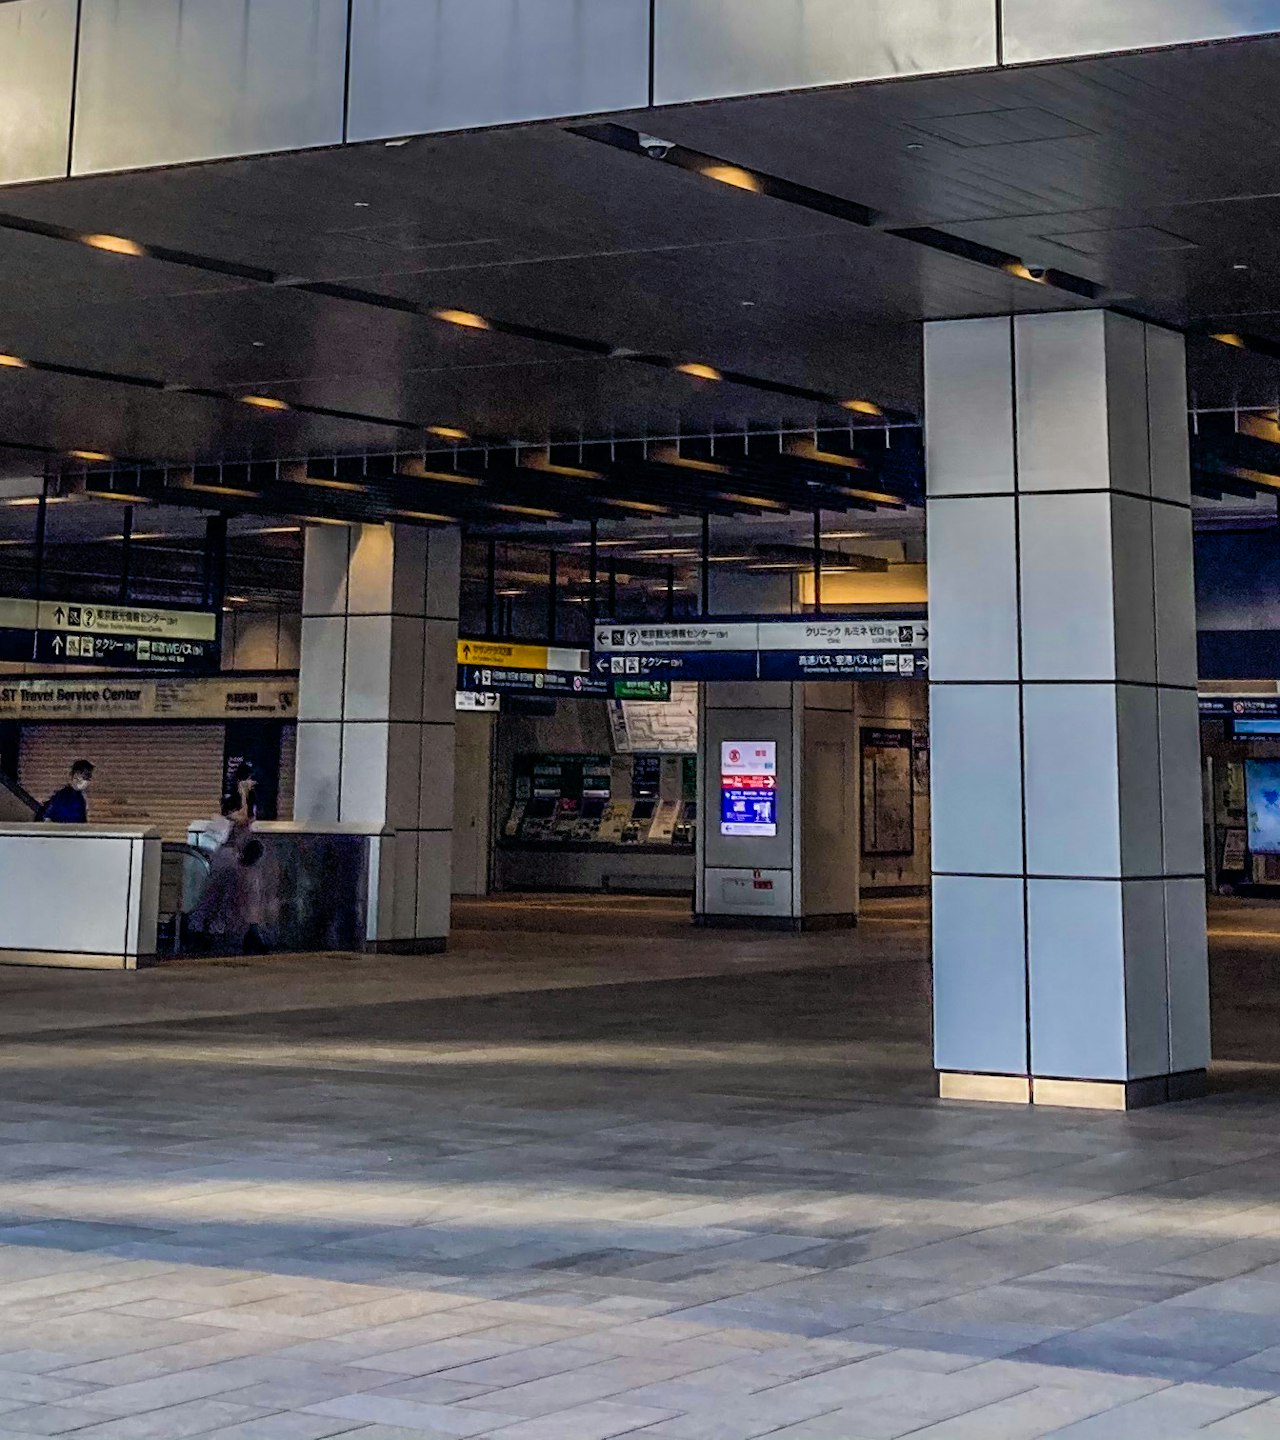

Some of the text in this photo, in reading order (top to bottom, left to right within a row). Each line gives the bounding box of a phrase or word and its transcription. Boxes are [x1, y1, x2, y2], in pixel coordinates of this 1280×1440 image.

[805, 626, 841, 636] クリニック
[21, 689, 54, 701] Travel
[57, 688, 99, 701] Service
[103, 687, 141, 701] Center
